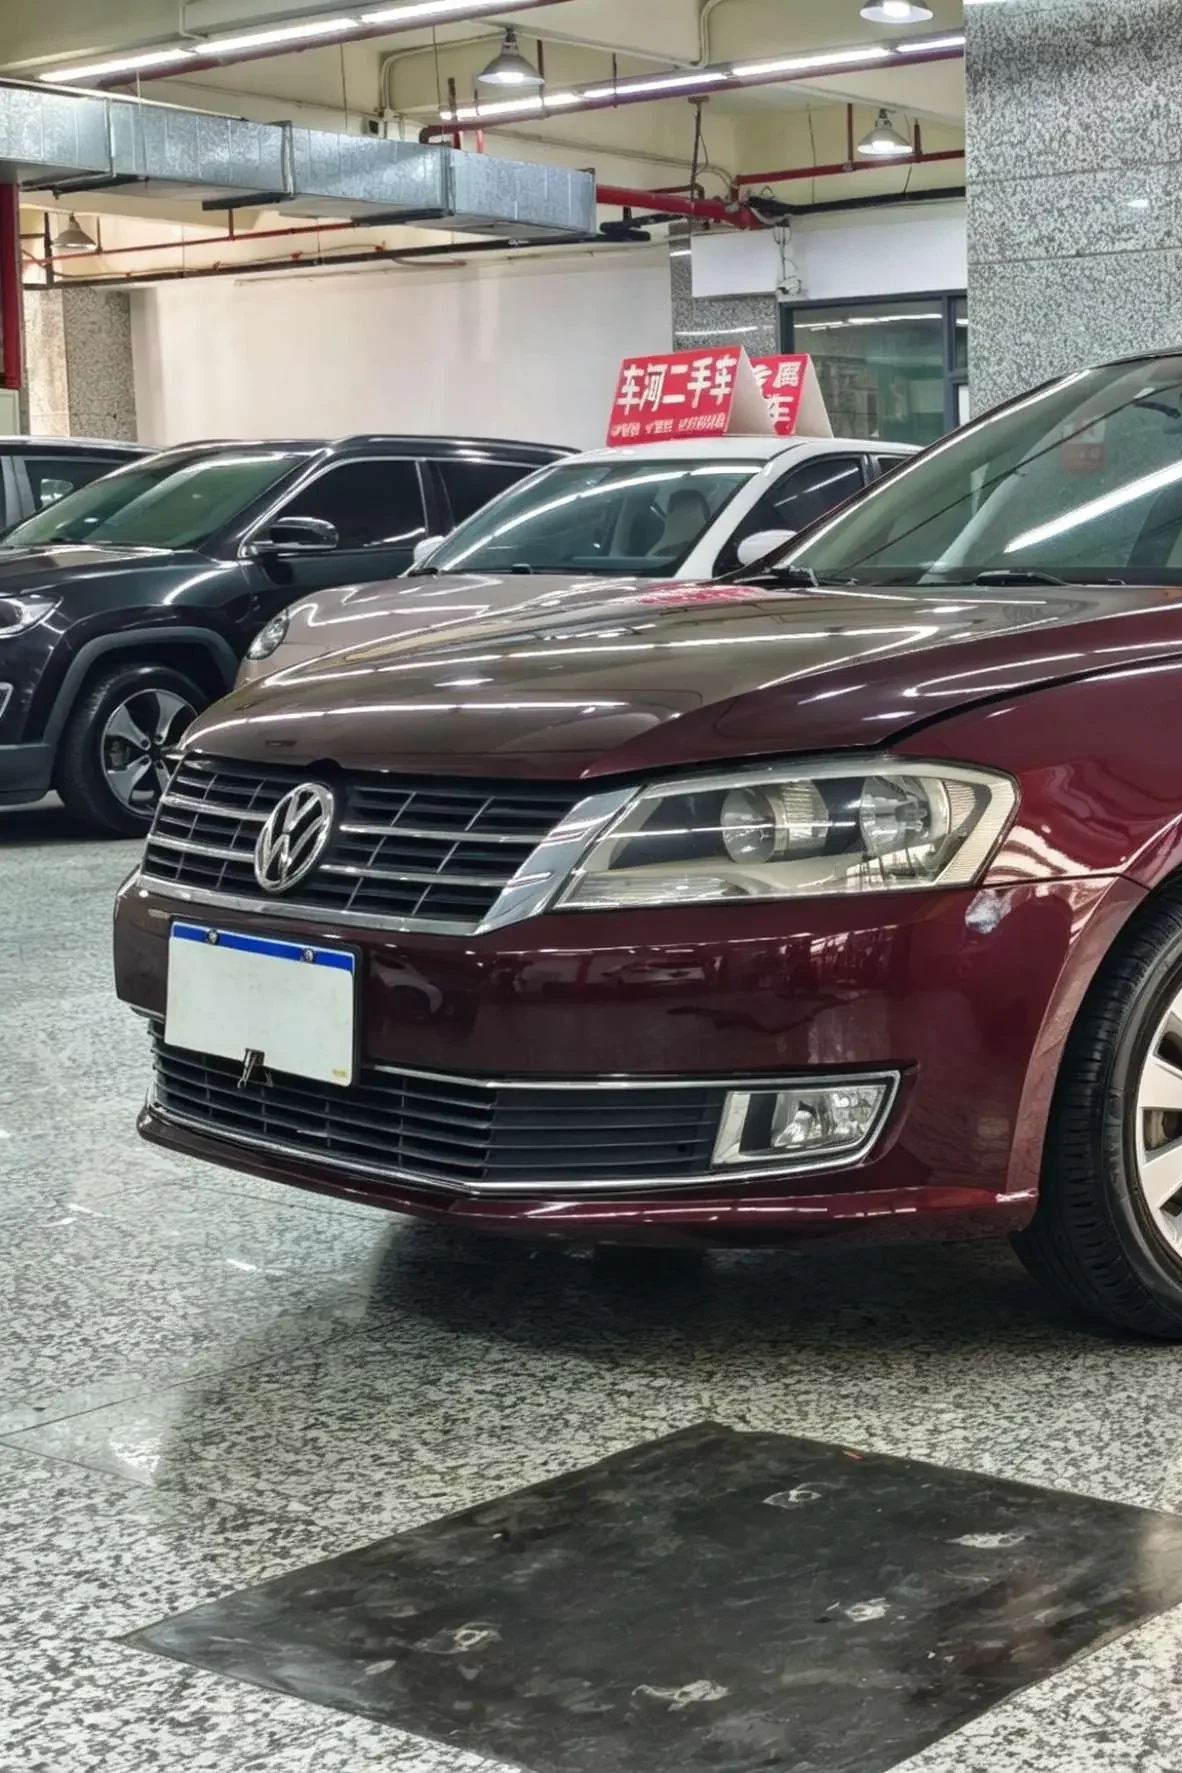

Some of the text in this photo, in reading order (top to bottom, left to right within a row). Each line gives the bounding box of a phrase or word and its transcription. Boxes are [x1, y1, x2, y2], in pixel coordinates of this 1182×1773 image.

[616, 354, 737, 415] 车河二手车
